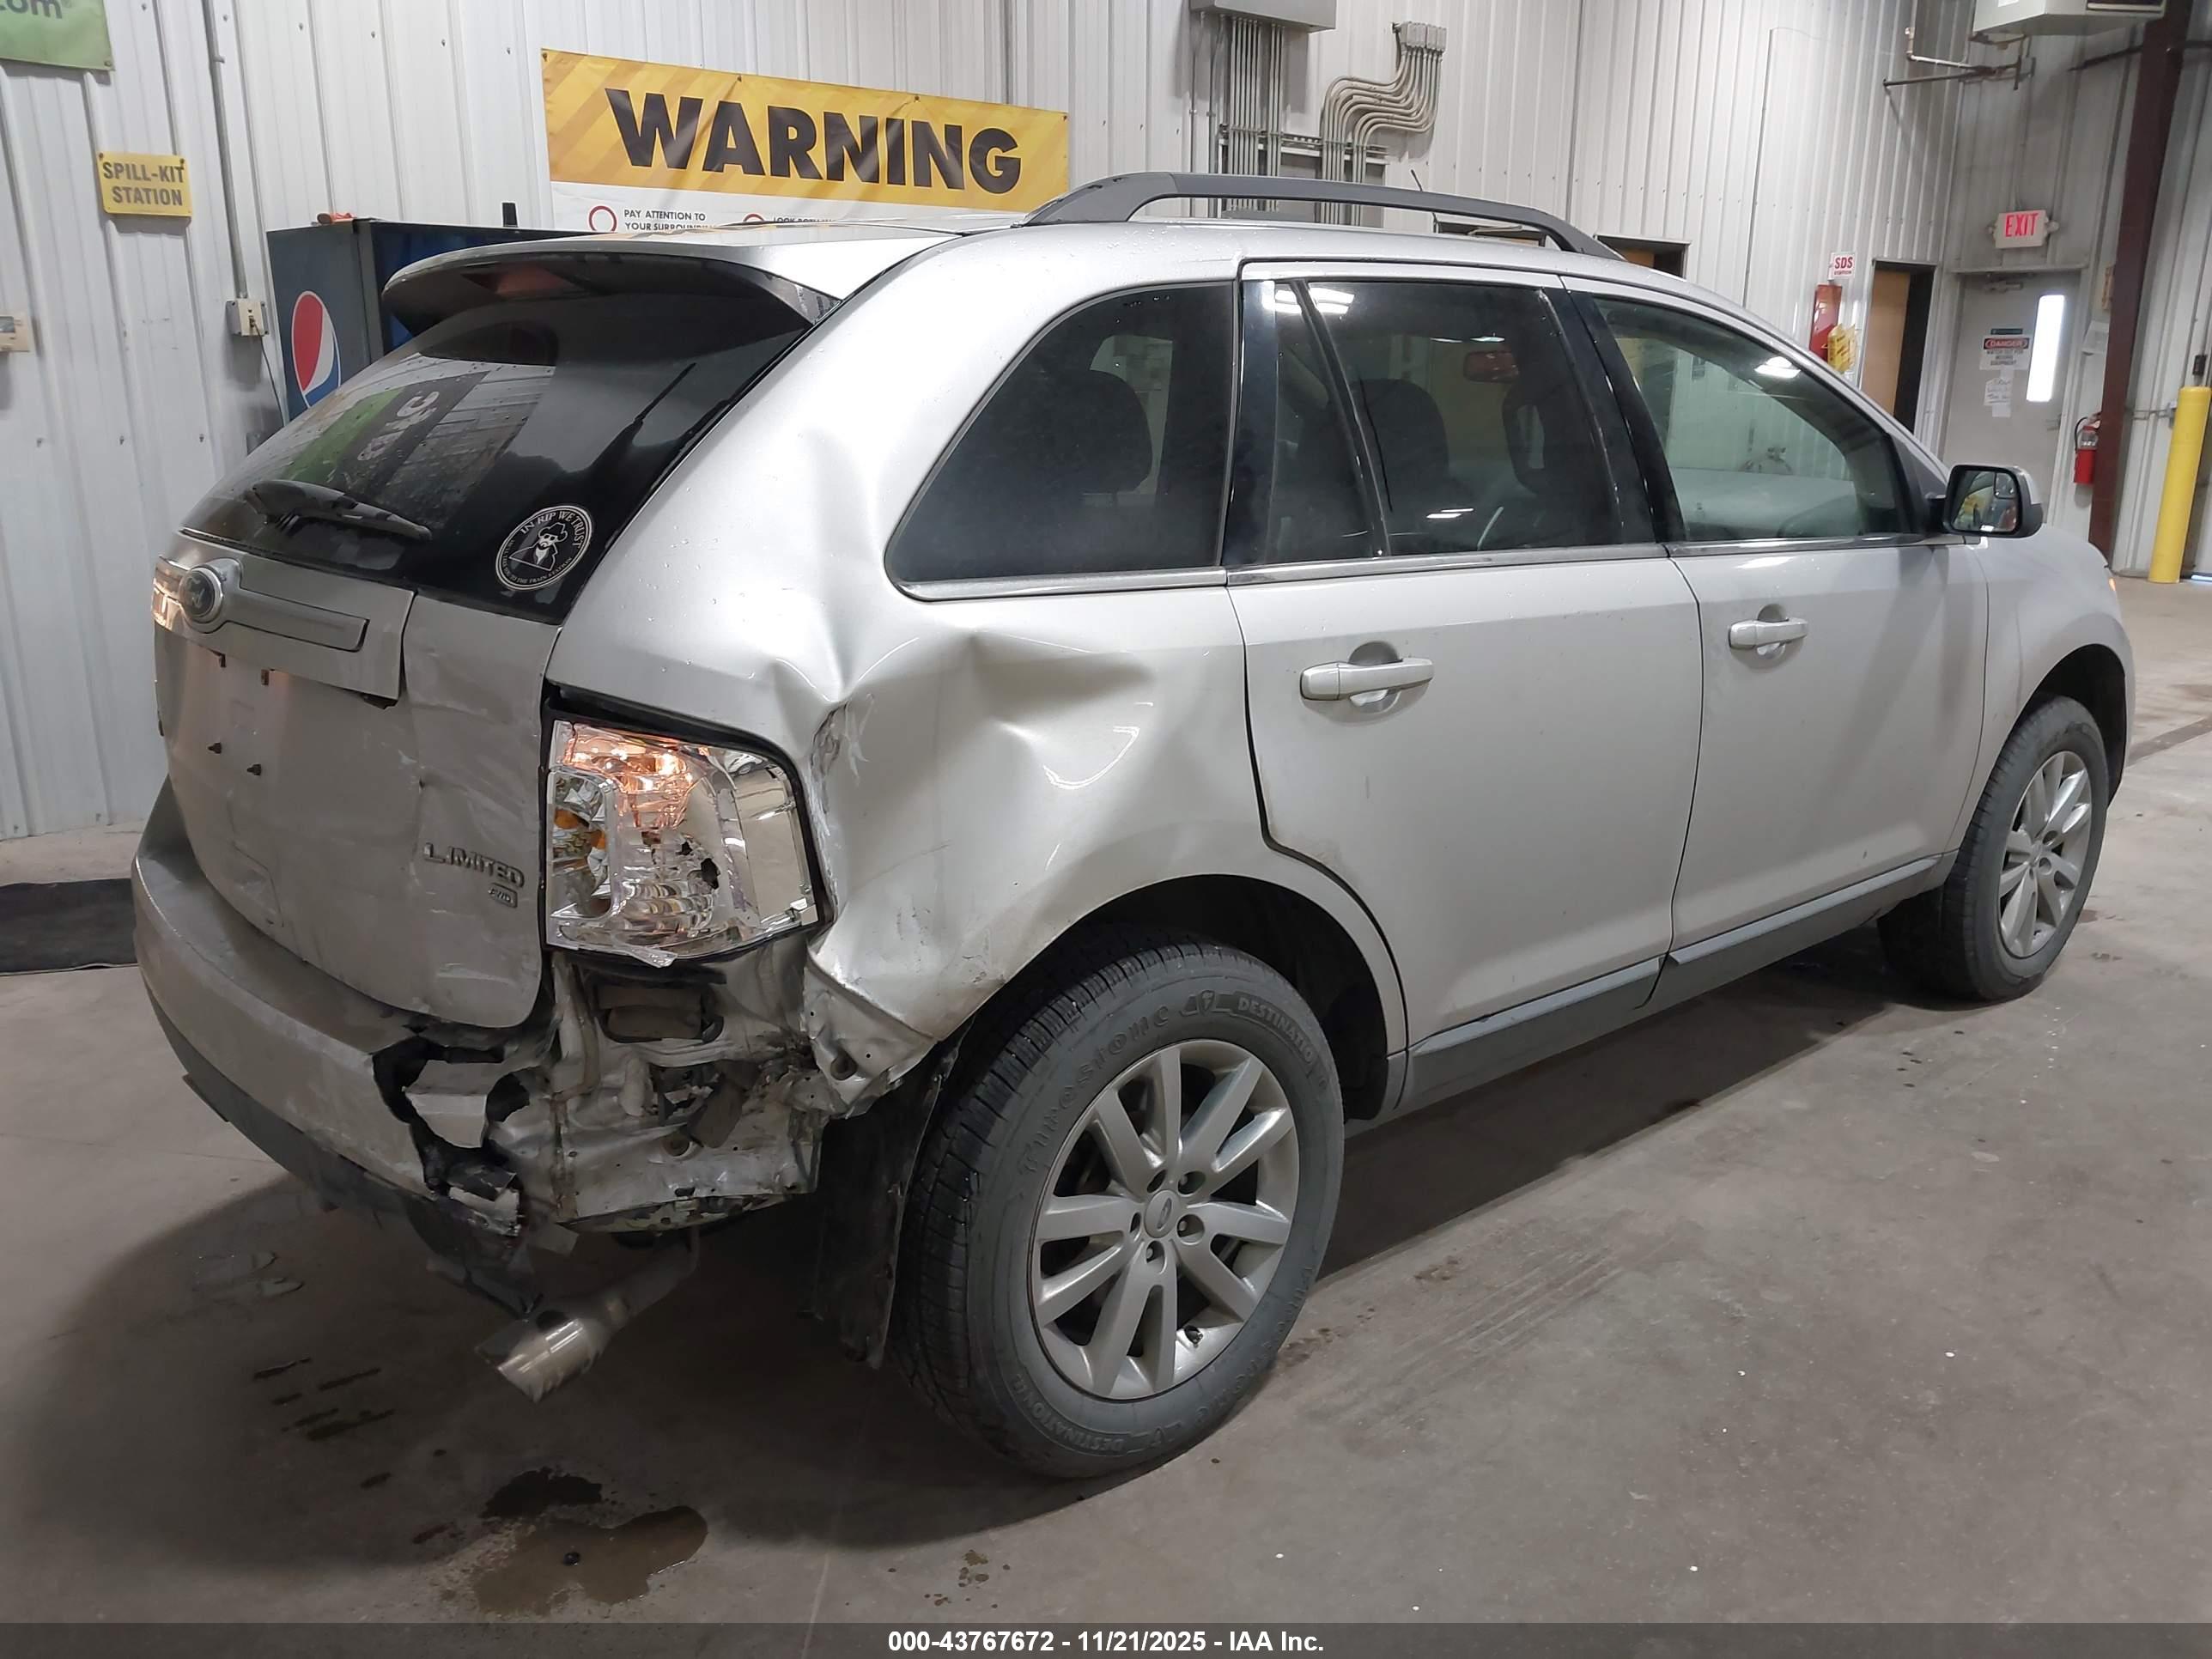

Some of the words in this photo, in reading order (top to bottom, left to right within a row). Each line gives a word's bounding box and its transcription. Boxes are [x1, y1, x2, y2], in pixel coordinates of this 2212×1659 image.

[0, 0, 63, 19] om
[605, 88, 1022, 194] WARNING
[102, 161, 184, 183] SPILL-KIT
[112, 185, 182, 206] STATION
[624, 209, 641, 218] PAY
[645, 210, 691, 221] ATTENTION
[694, 213, 706, 222] TO
[2005, 212, 2039, 237] EXIT
[624, 222, 651, 231] YOUR
[1834, 256, 1853, 269] SDS
[520, 521, 535, 534] IN
[538, 512, 556, 524] RIP
[558, 510, 575, 521] WE
[571, 516, 585, 549] TRUST
[423, 842, 526, 889] LIMITED
